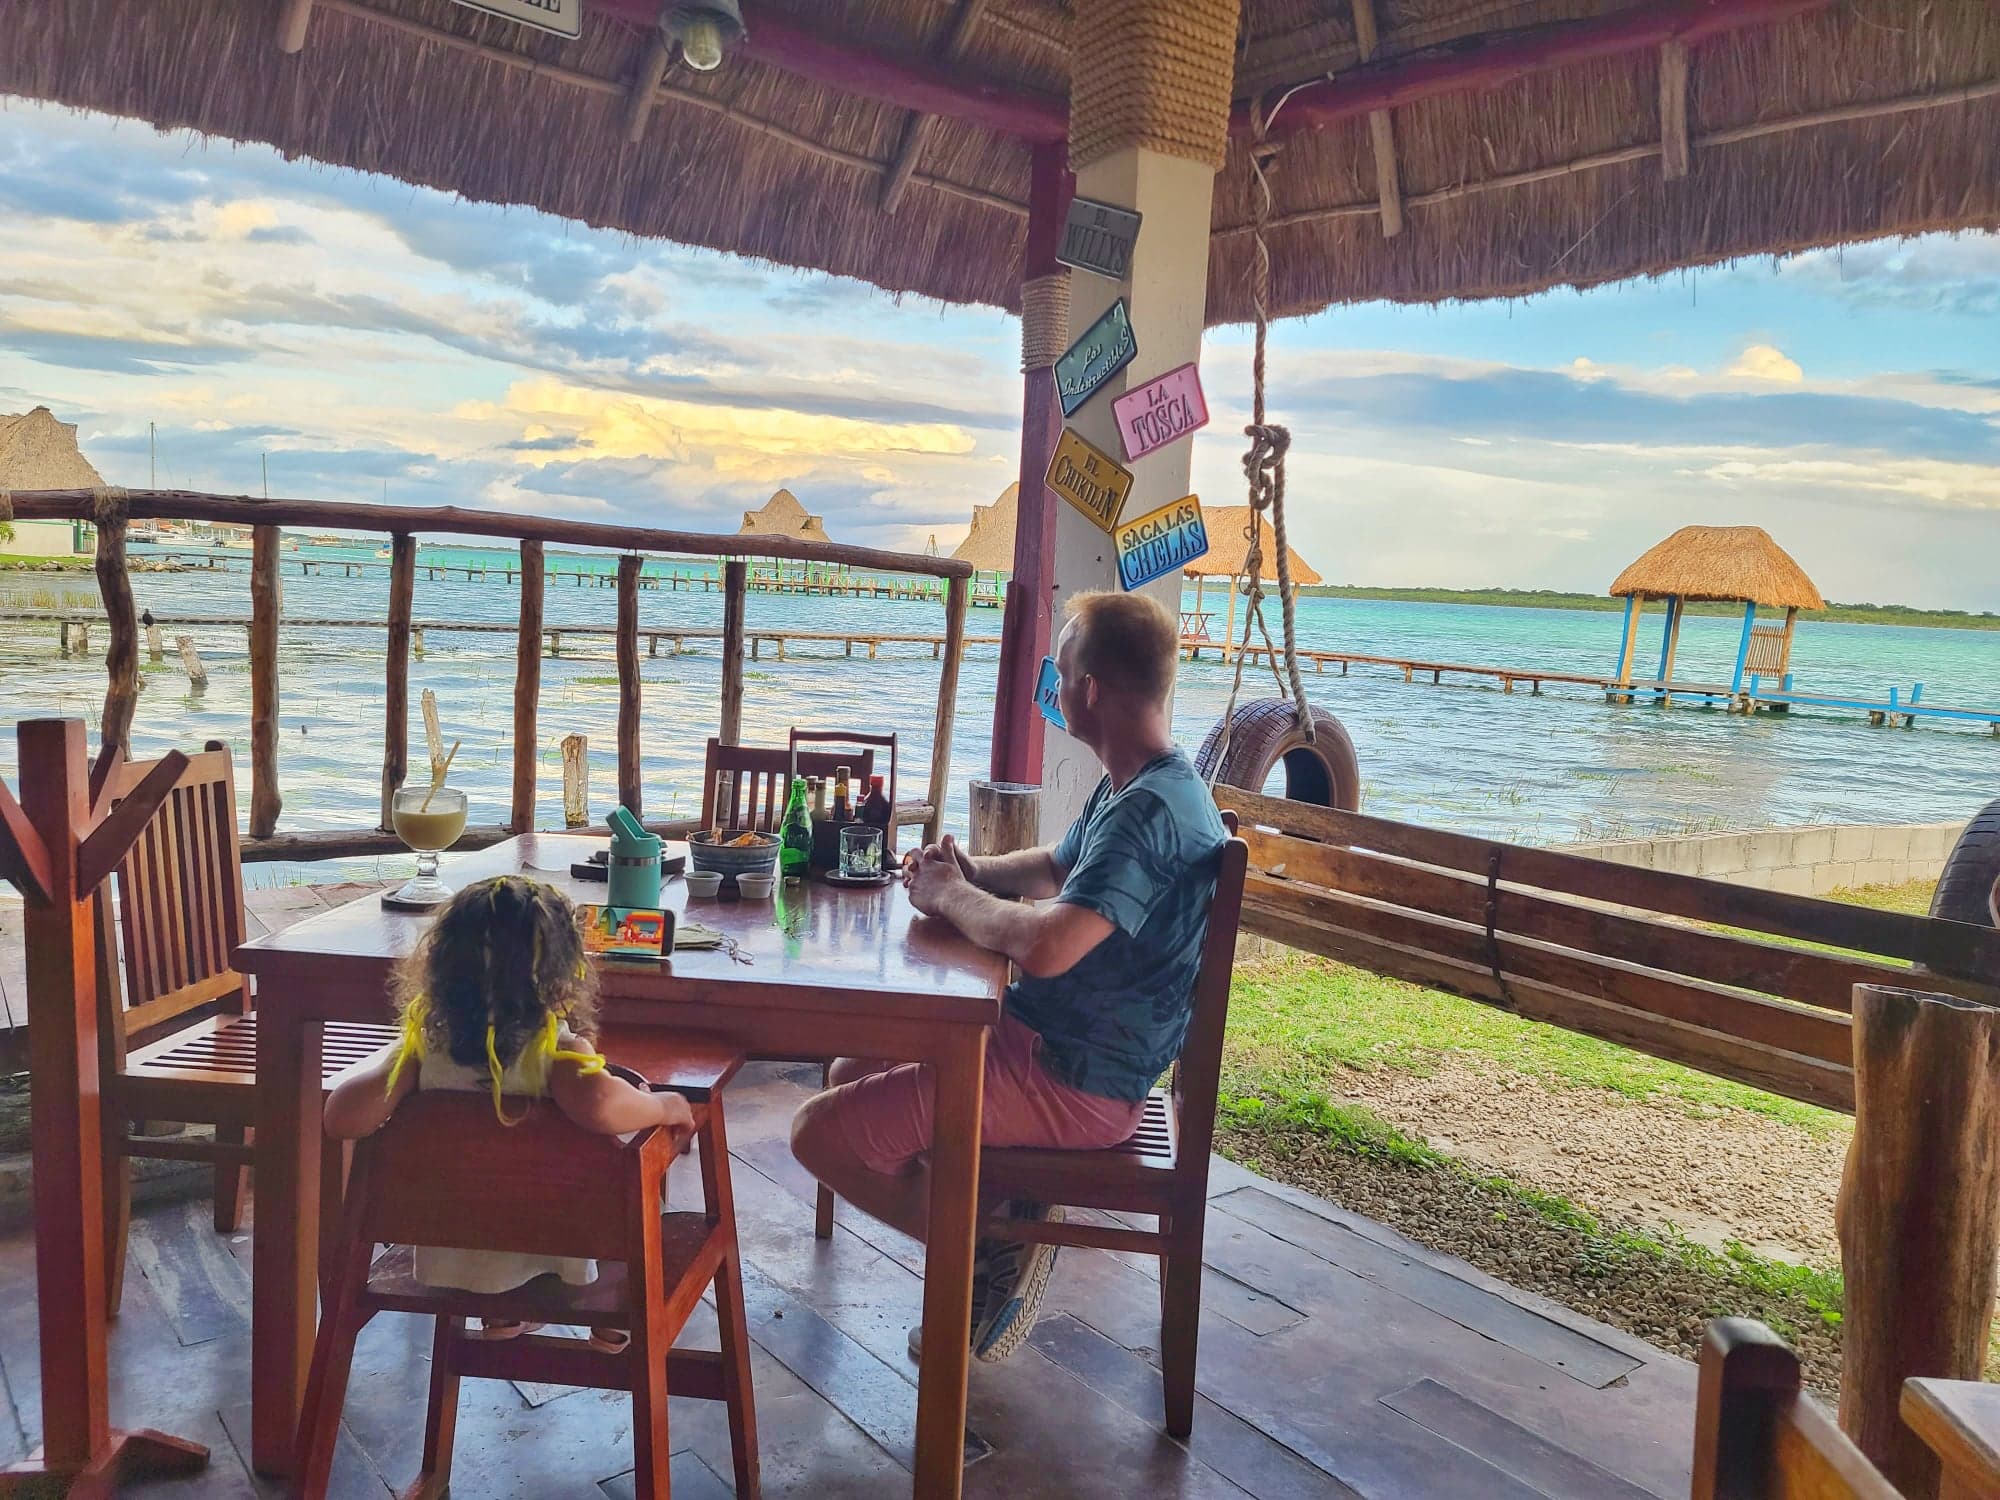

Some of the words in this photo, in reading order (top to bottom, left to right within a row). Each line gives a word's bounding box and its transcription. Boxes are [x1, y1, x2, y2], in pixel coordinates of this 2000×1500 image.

[1083, 343, 1102, 374] Los
[1147, 384, 1169, 407] LA
[1131, 393, 1195, 451] TOSCA
[1084, 452, 1100, 477] EL
[1123, 520, 1202, 583] CHELAS
